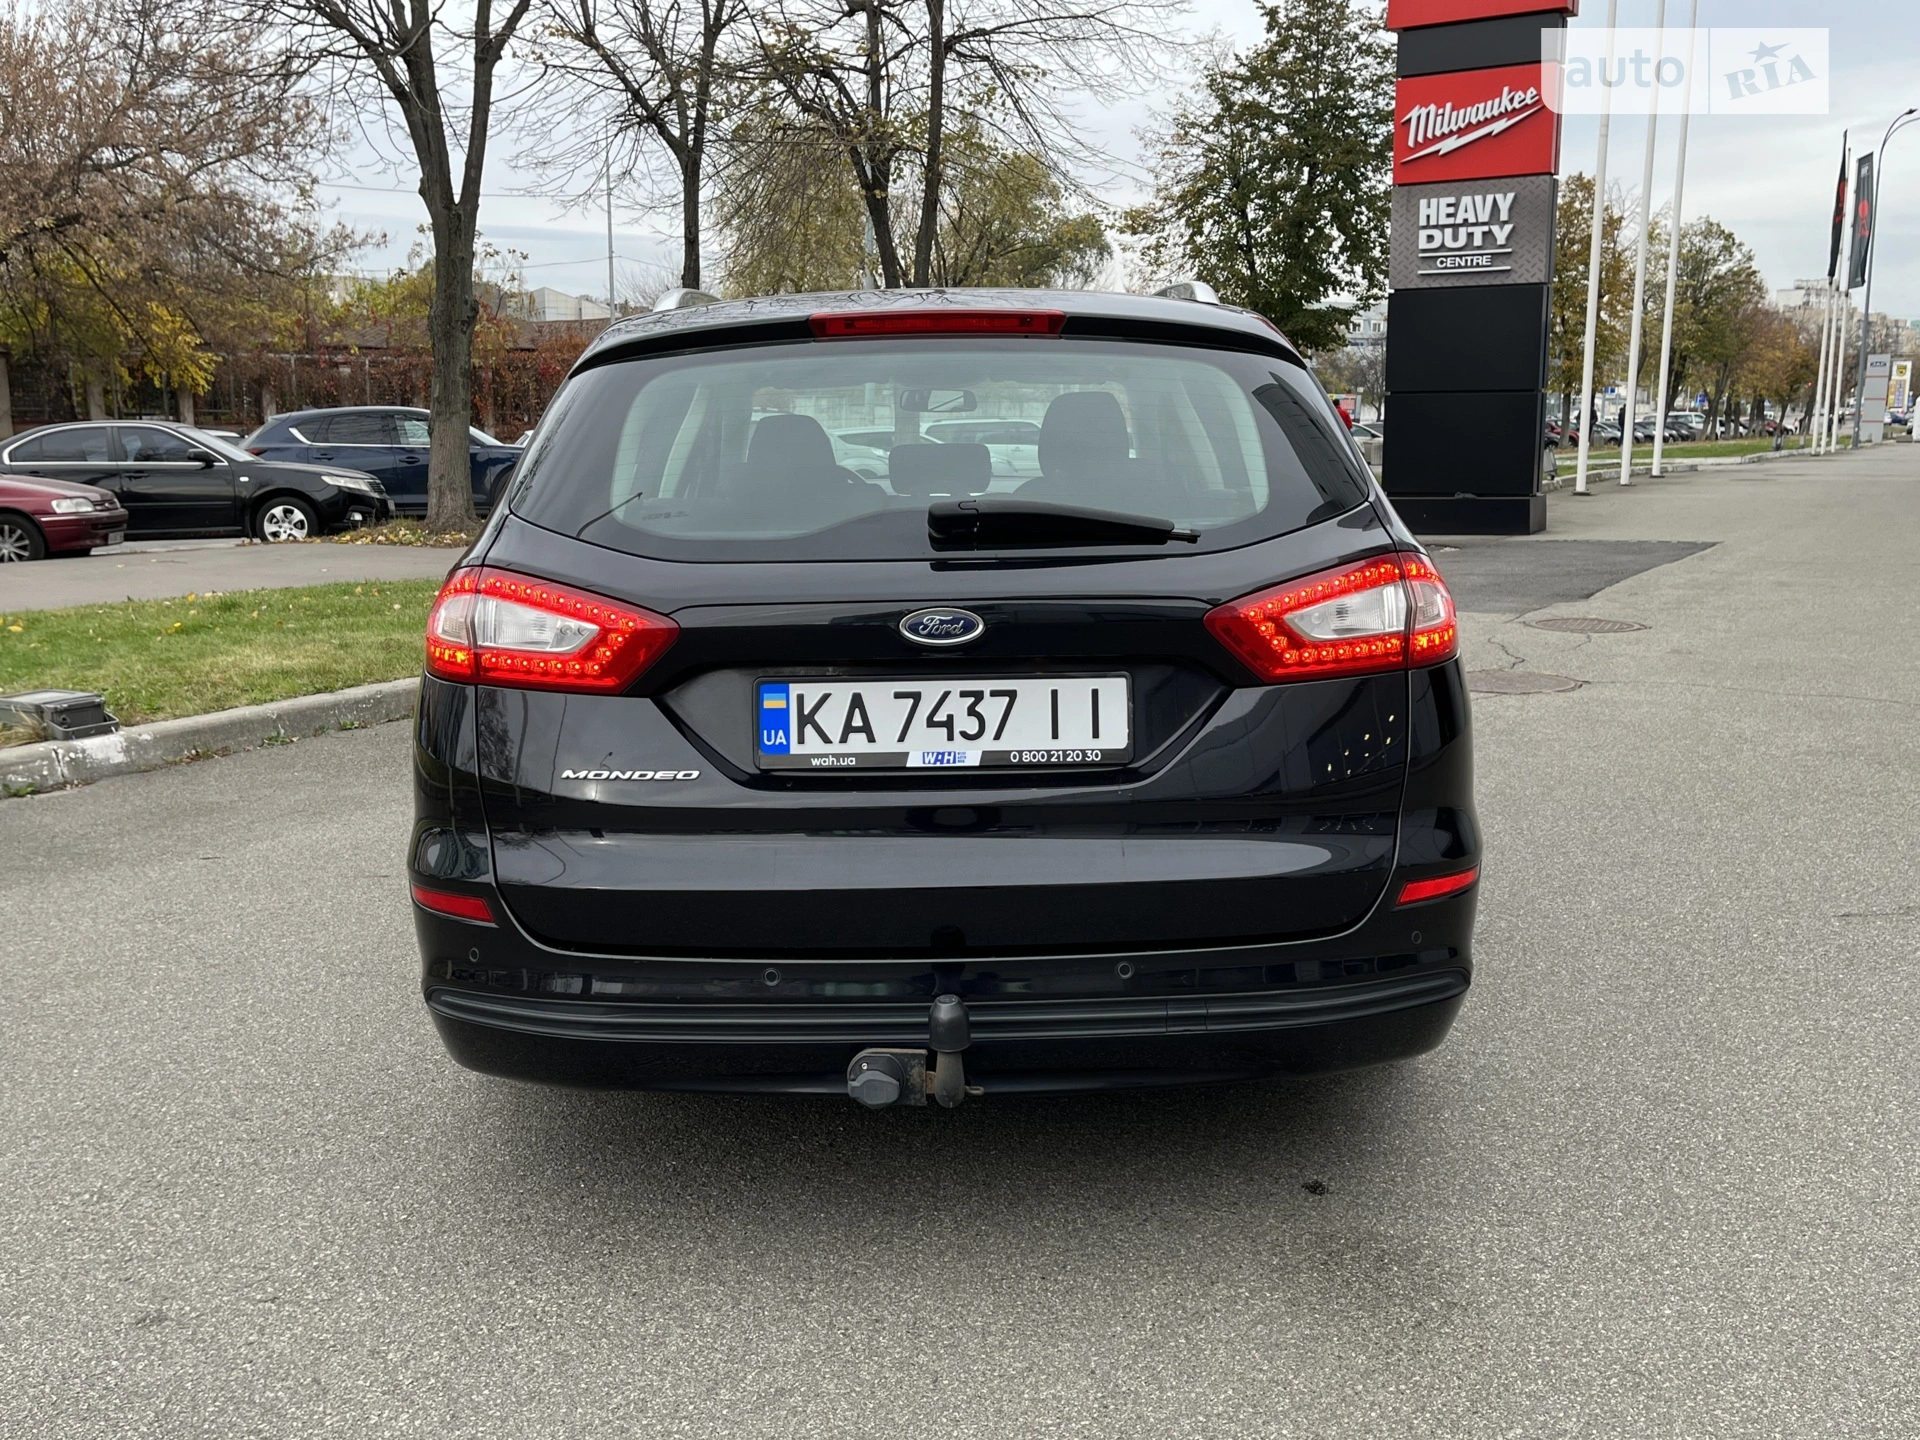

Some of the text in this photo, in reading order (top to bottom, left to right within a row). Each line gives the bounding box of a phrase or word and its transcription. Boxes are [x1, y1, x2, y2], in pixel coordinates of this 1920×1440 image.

[1401, 86, 1541, 148] Milwaukee
[1419, 192, 1516, 226] HEAVY
[1418, 223, 1514, 250] DUTY
[1436, 254, 1492, 268] CENTRE
[919, 615, 965, 635] Ford
[796, 691, 876, 744] KA
[893, 689, 1018, 743] 7437
[763, 729, 787, 745] UA
[810, 755, 856, 766] wah.ua
[923, 751, 956, 765] WAH
[1010, 750, 1101, 762] 0 800 21 20 30
[560, 769, 701, 780] MONDEO
